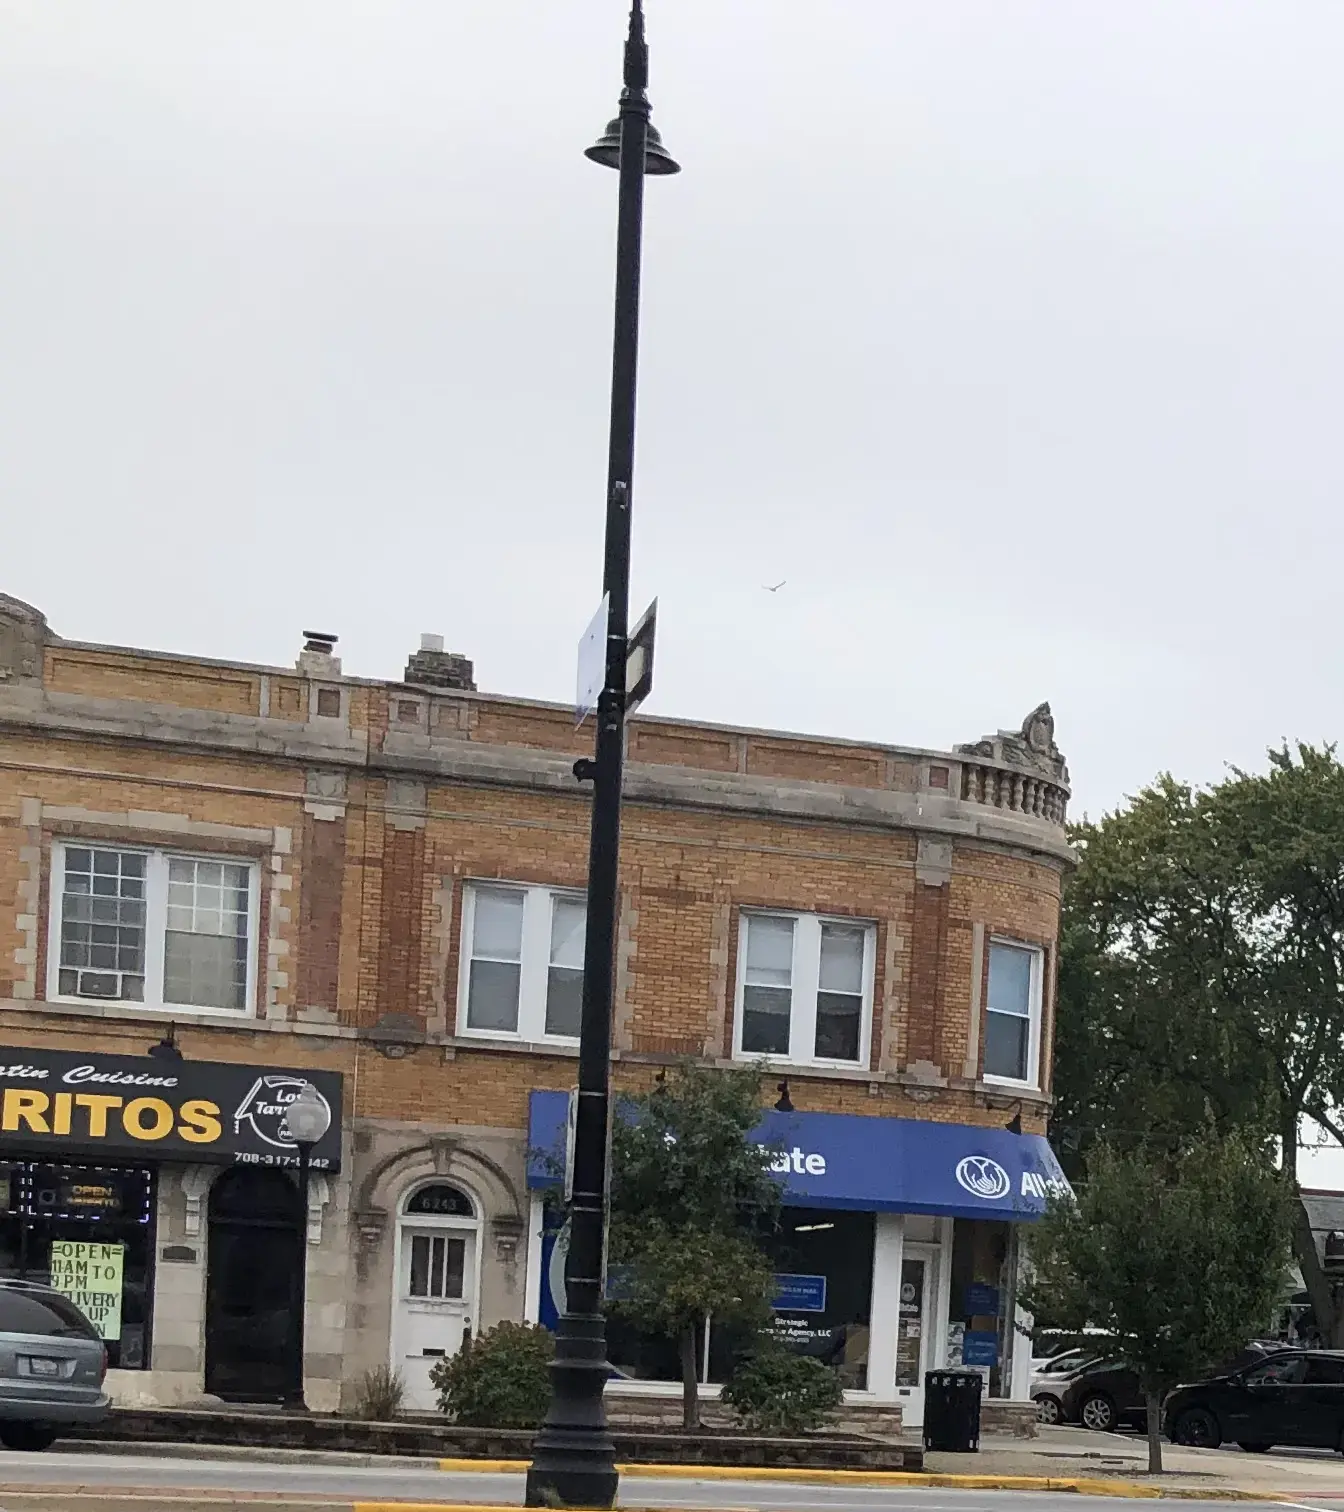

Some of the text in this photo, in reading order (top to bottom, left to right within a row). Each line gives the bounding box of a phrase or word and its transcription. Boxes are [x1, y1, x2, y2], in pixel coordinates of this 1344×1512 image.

[62, 1065, 179, 1087] Cuisine
[2, 1088, 222, 1143] RITOS
[92, 1265, 116, 1280] TO
[64, 1275, 88, 1289] PM
